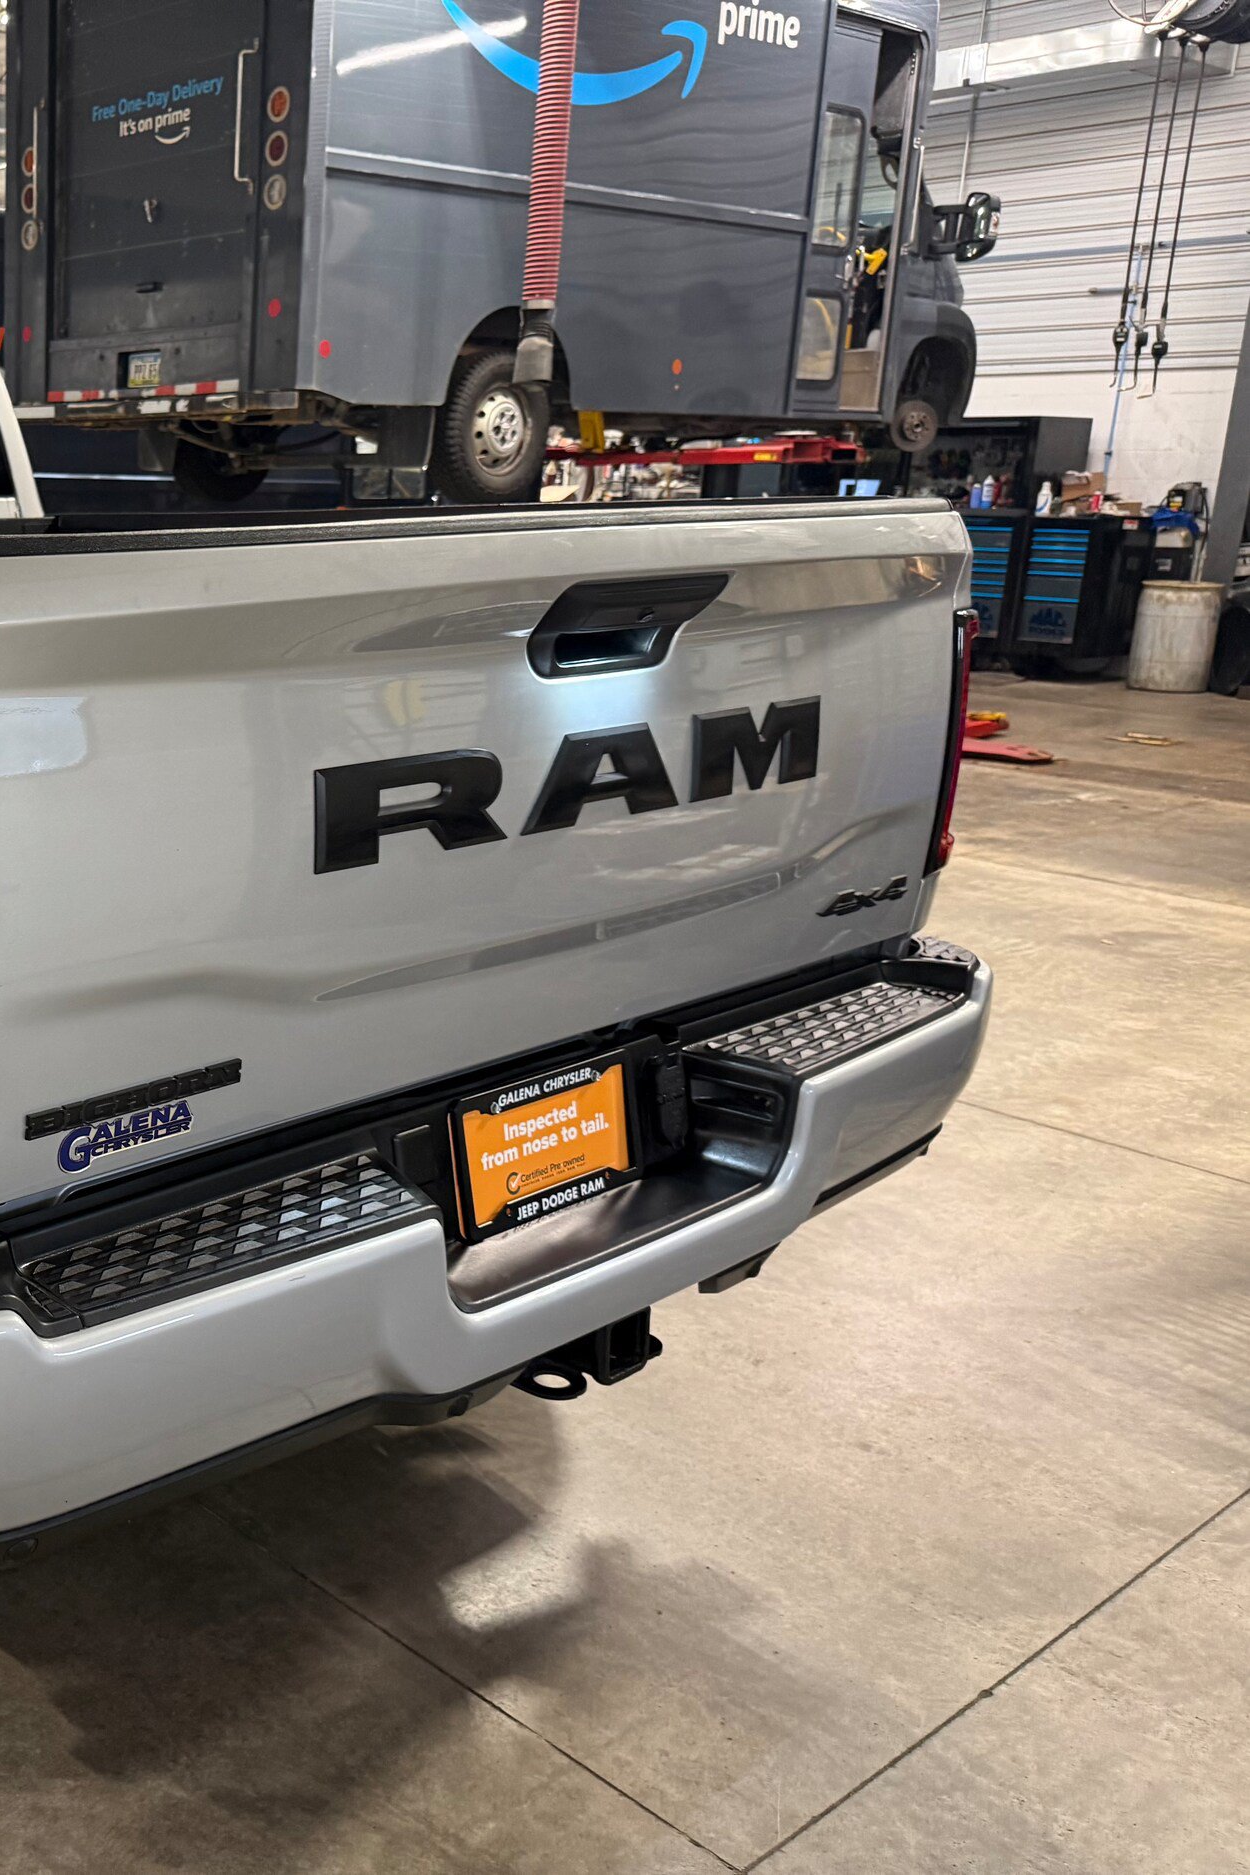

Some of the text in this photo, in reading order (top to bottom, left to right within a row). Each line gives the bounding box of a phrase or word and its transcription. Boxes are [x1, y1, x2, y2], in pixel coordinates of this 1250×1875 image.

[717, 0, 801, 49] prime
[92, 76, 224, 122] Free One-Day Delivery
[119, 107, 192, 137] It's on prime
[313, 695, 822, 875] RAM
[498, 1067, 592, 1107] GALENA CHRYSLER
[58, 1100, 194, 1173] GALENA
[91, 1121, 191, 1157] CHRYSLER
[480, 1112, 610, 1171] from nose to tail.
[503, 1101, 578, 1142] Inspected
[521, 1164, 549, 1183] Certified
[549, 1159, 563, 1173] Pre
[562, 1153, 586, 1168] owned
[516, 1177, 606, 1221] JEEP DODGE RAM
